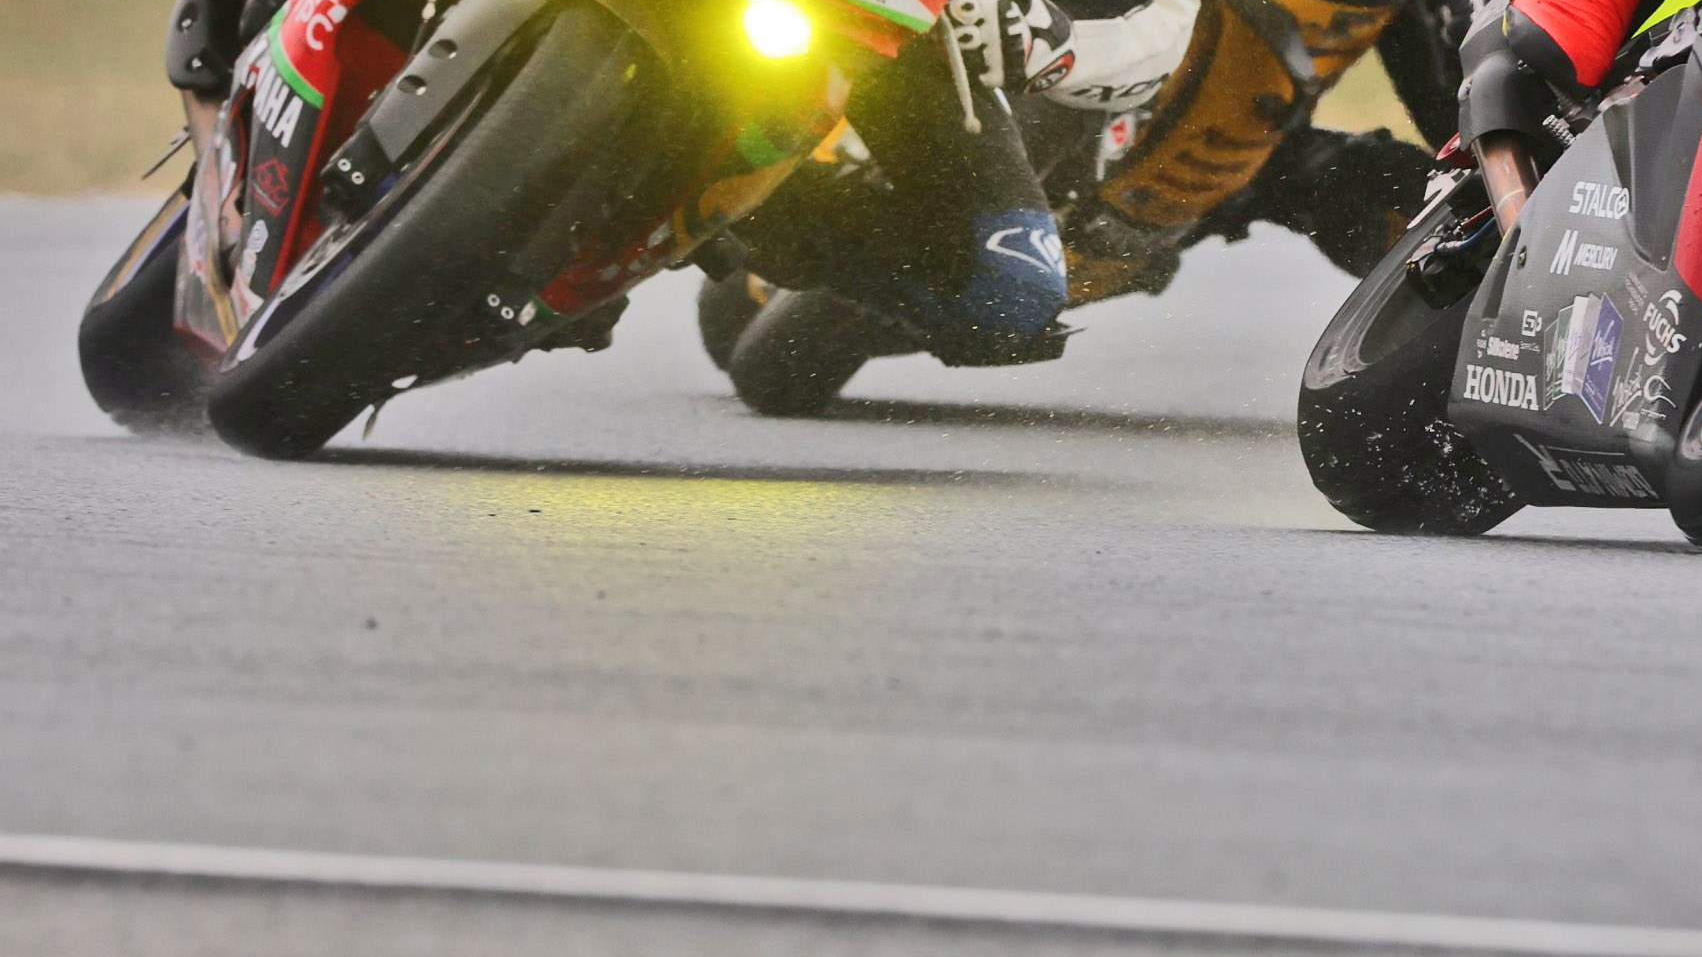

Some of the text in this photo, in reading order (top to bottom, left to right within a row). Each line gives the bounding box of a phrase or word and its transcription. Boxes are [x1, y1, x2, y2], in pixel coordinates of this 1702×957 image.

[1569, 181, 1629, 220] STALCO
[1573, 243, 1619, 271] MERCURY
[1643, 301, 1687, 354] FUCHS
[1463, 364, 1540, 412] HONDA
